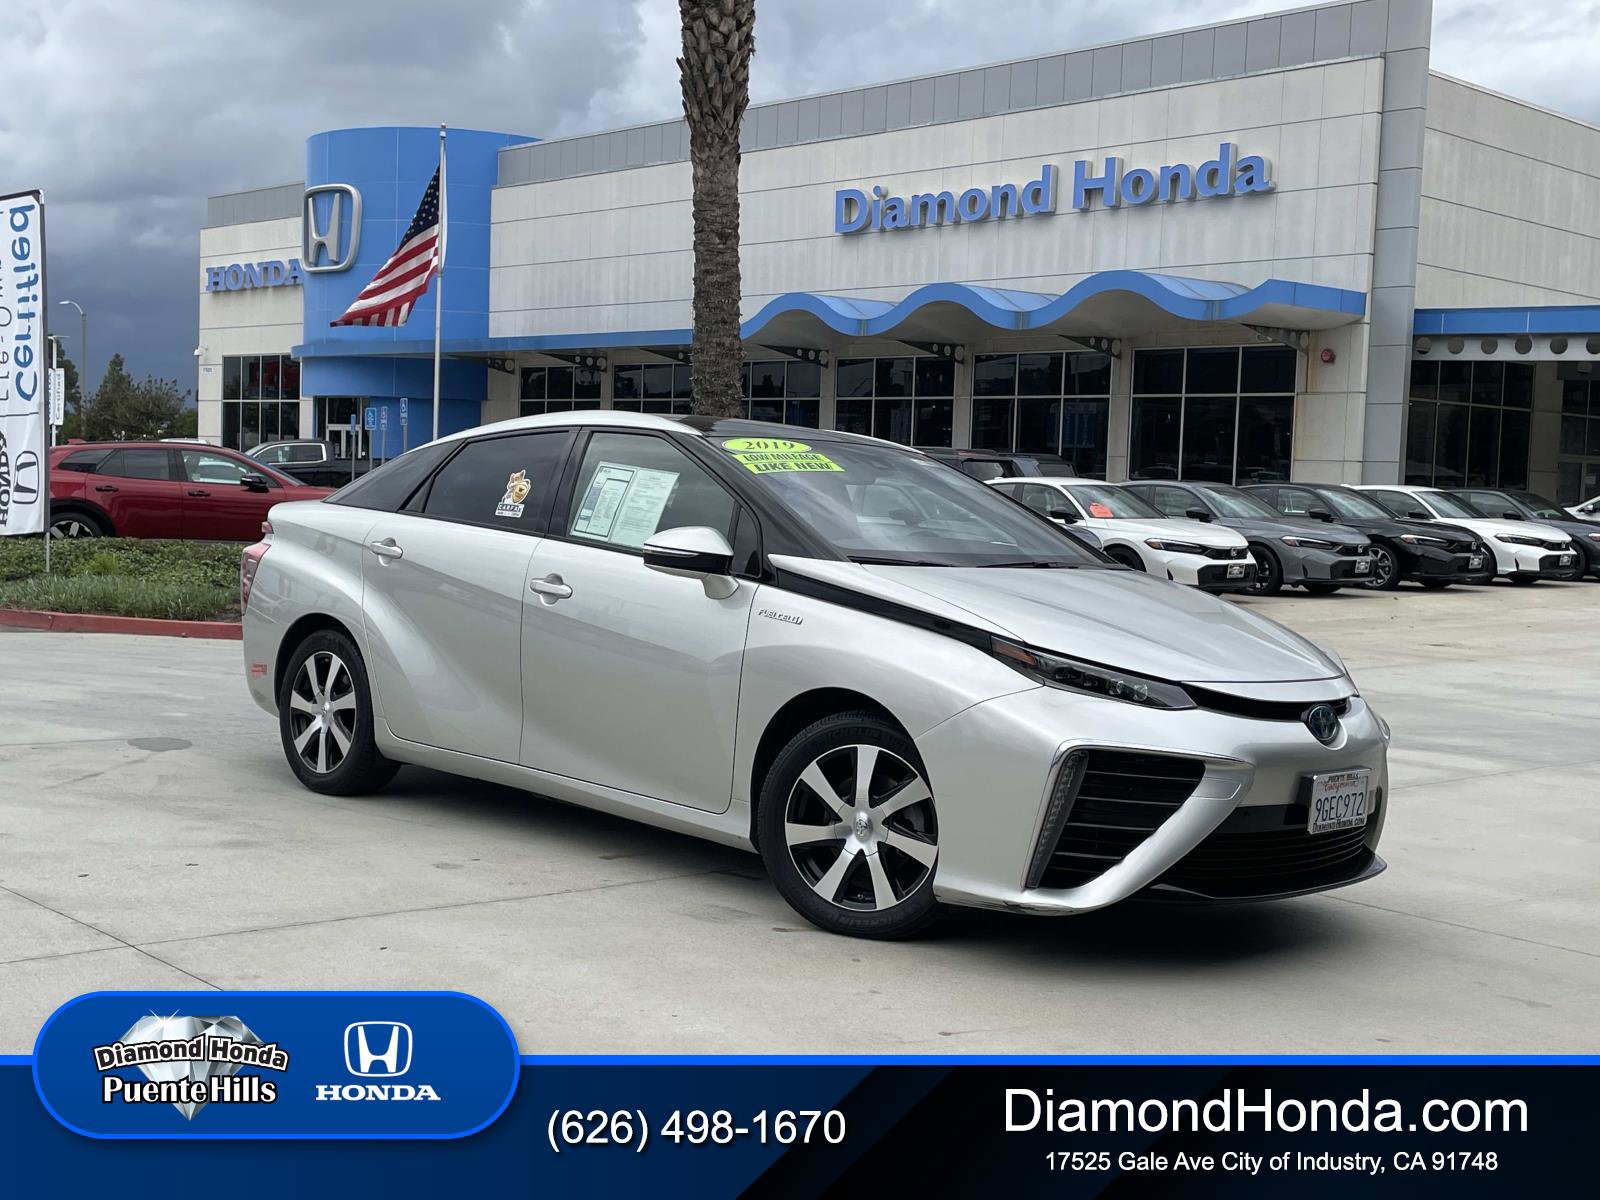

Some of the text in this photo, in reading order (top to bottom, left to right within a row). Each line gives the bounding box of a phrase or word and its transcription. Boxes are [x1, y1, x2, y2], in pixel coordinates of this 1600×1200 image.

[834, 141, 1277, 234] Diamond Honda
[205, 258, 304, 291] HONDA
[744, 440, 795, 450] 2019
[743, 453, 822, 462] LOW MILEAGE
[753, 462, 832, 472] LIKE NEW
[1314, 791, 1364, 823] 9GEC972
